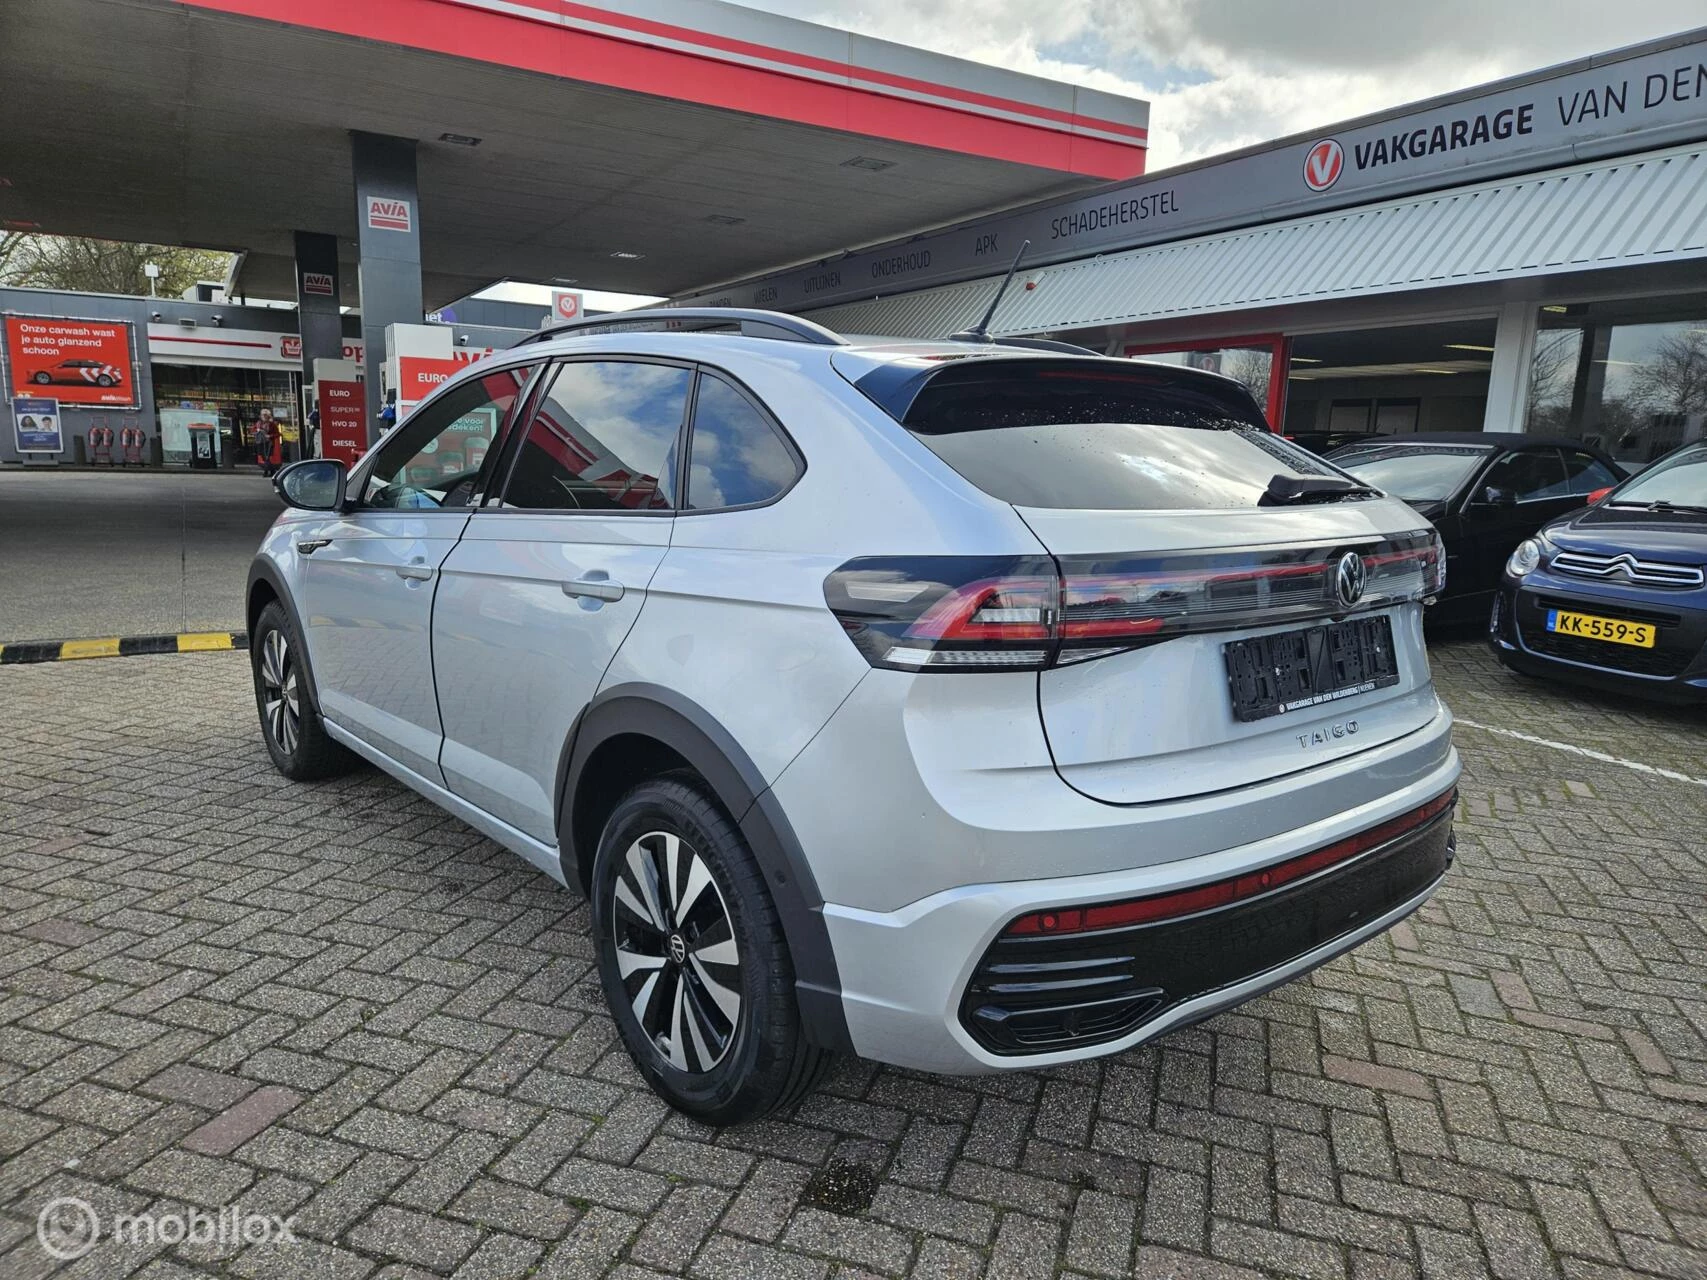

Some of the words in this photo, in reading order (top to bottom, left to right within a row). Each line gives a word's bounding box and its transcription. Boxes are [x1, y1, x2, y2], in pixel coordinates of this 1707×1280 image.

[1355, 104, 1534, 170] VAKGARAGE
[1557, 81, 1628, 126] VAN
[1051, 190, 1179, 239] SCHADEHERSTEL
[974, 233, 999, 256] APK
[871, 250, 931, 279] ONDERHOUD
[20, 324, 46, 333] Onze
[48, 326, 90, 336] carwash
[92, 329, 116, 337] wast
[21, 335, 31, 345] je
[33, 336, 56, 345] auto
[58, 337, 102, 347] glanzend
[22, 346, 60, 355] schoon
[417, 372, 449, 383] EURO
[329, 389, 351, 398] EURO
[331, 420, 347, 428] HVO
[332, 439, 357, 447] DIESEL
[1559, 614, 1647, 643] KK-559-S
[1286, 697, 1314, 711] VAKGARAGE
[1313, 695, 1323, 704] VAN
[1296, 720, 1359, 748] TAIGO
